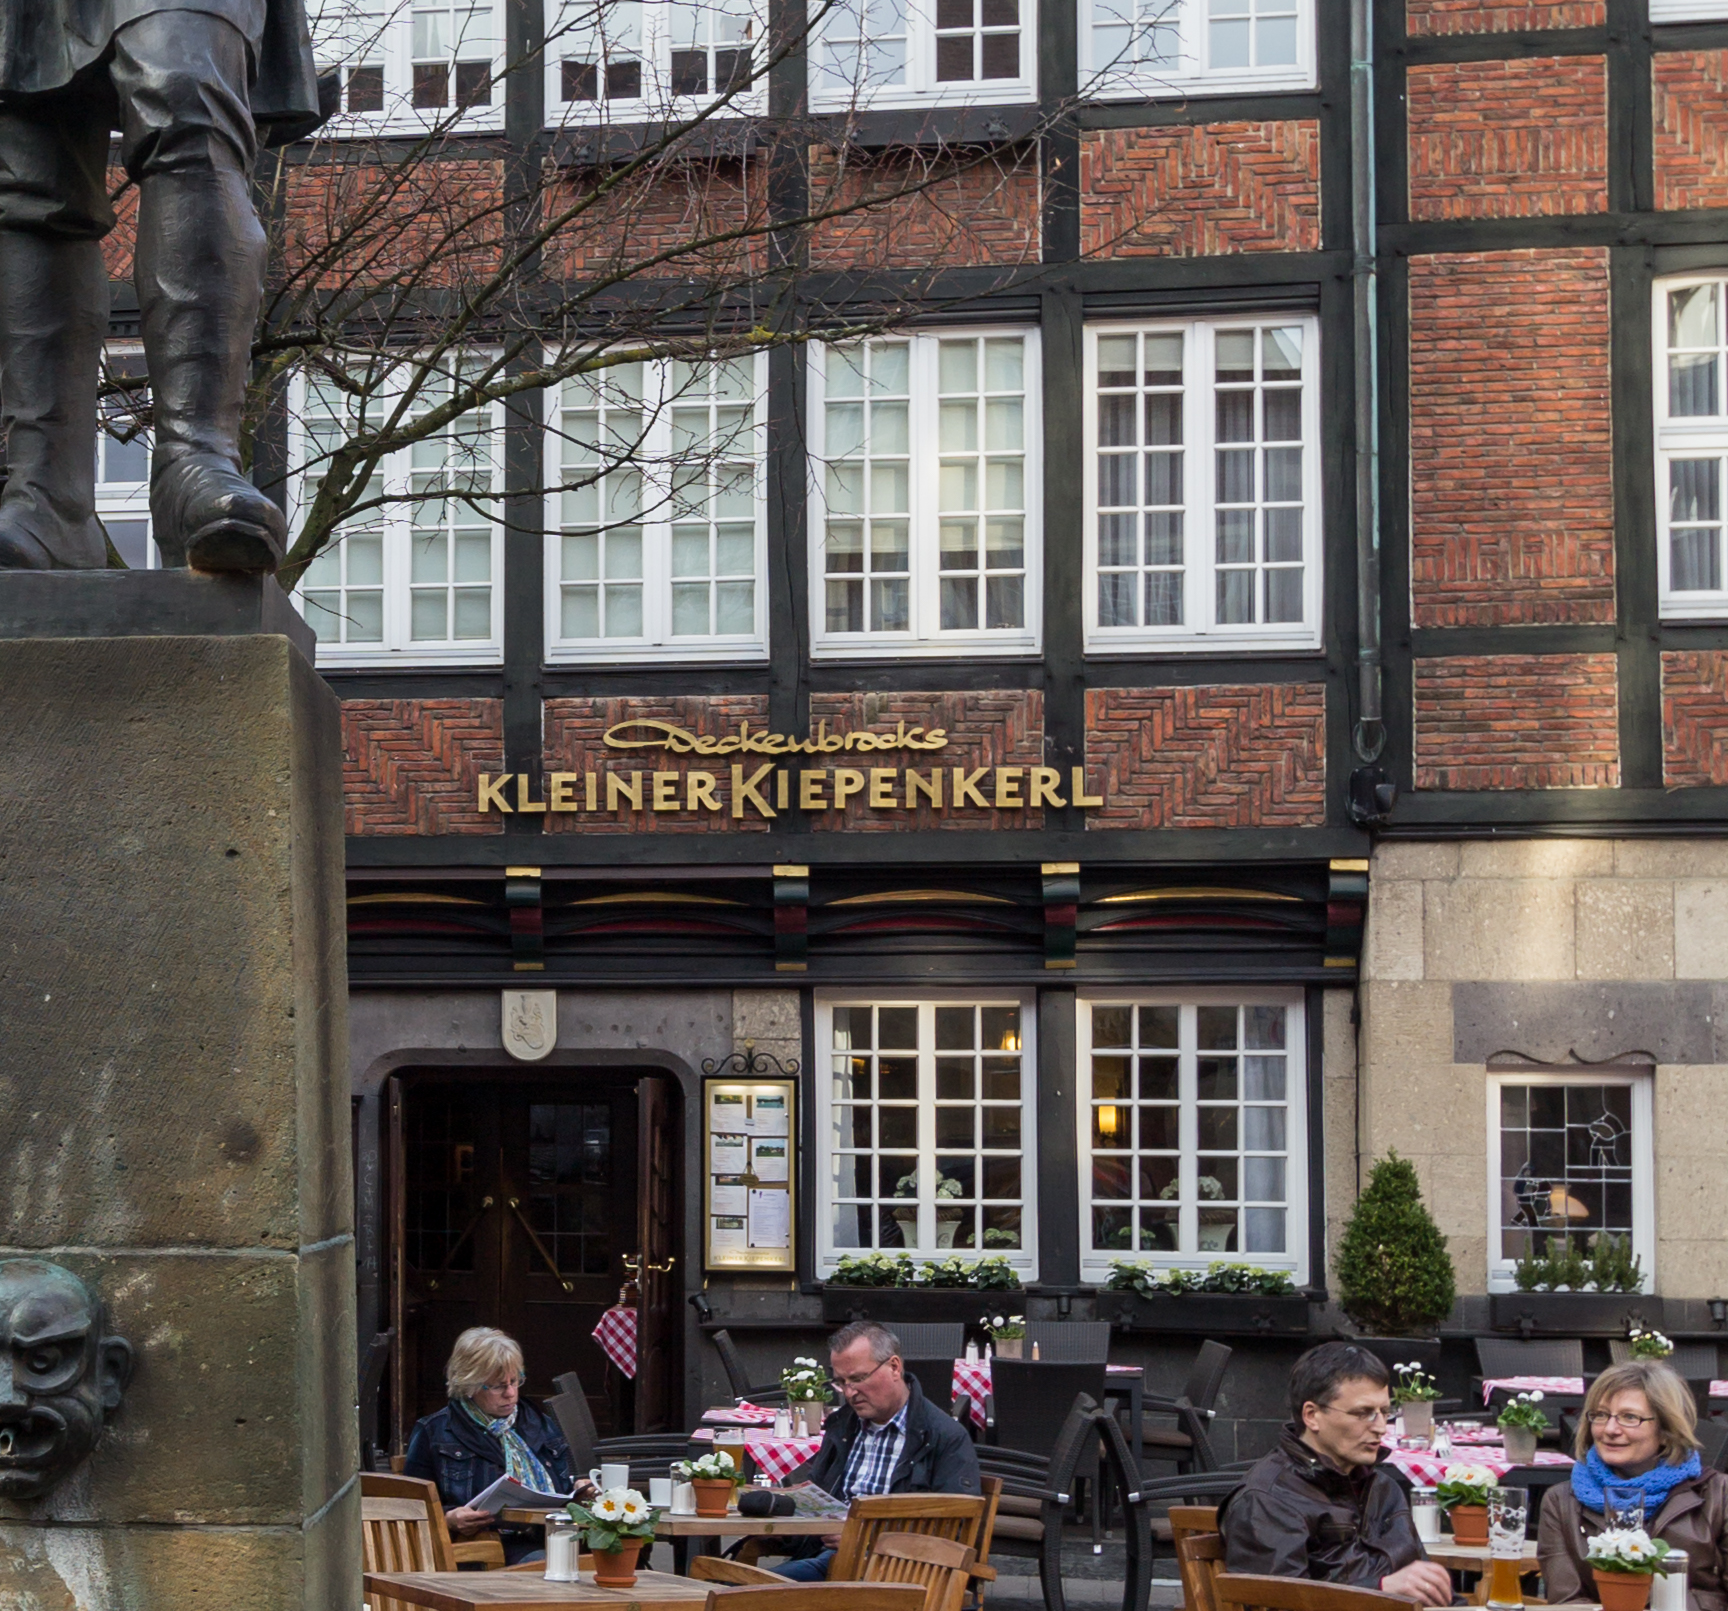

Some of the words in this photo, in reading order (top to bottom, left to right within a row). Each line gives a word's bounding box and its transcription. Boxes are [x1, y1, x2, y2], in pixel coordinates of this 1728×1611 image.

[603, 719, 949, 755] Deckenbrocks
[478, 770, 723, 813] KLEINER
[731, 762, 1104, 819] KIEPENKERL
